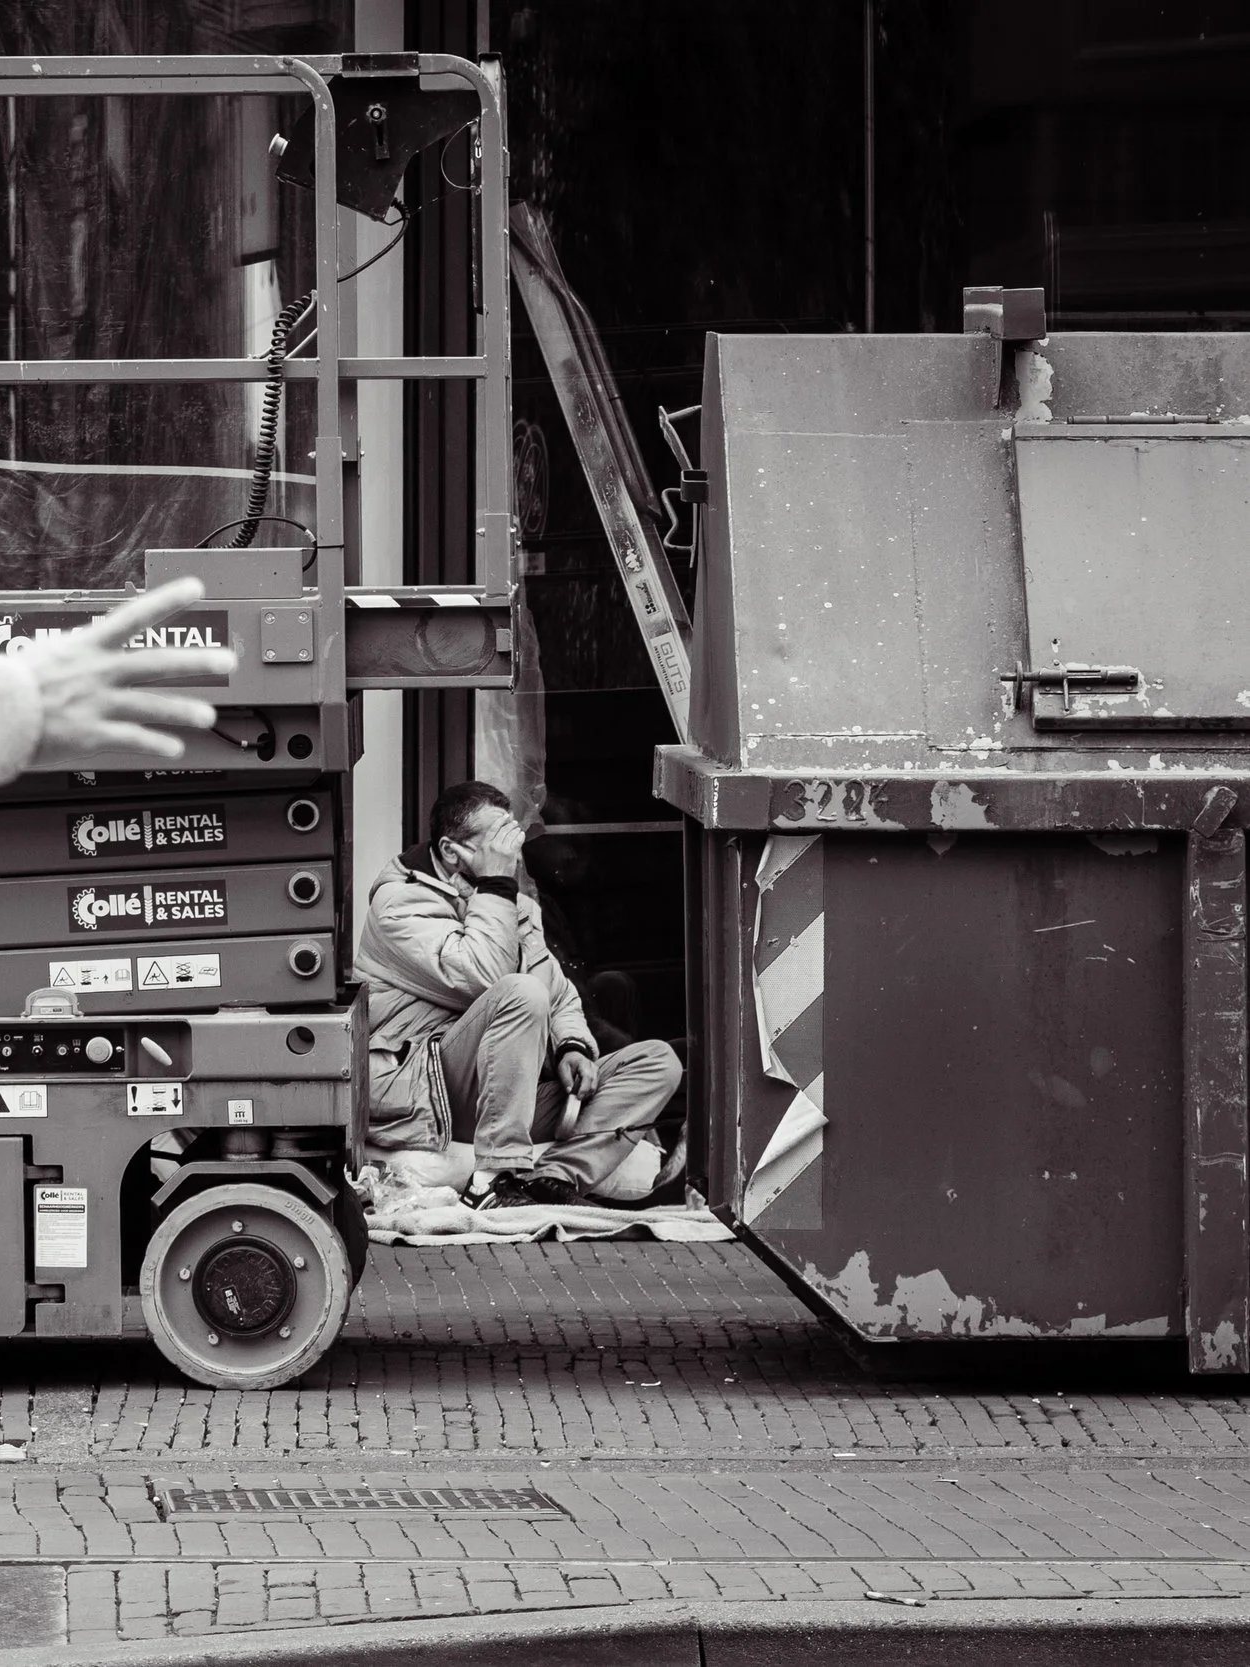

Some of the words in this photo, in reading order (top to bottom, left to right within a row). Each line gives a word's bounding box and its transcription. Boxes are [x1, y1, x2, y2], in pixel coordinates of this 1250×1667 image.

[123, 627, 222, 648] ENTAL
[660, 641, 687, 693] GUTS
[154, 814, 223, 830] RENTAL
[77, 818, 141, 850] Collé
[156, 832, 168, 845] &
[171, 828, 225, 845] SALES
[155, 889, 223, 905] RENTAL
[77, 892, 142, 925] Collé
[156, 907, 169, 920] &
[171, 904, 225, 920] SALES
